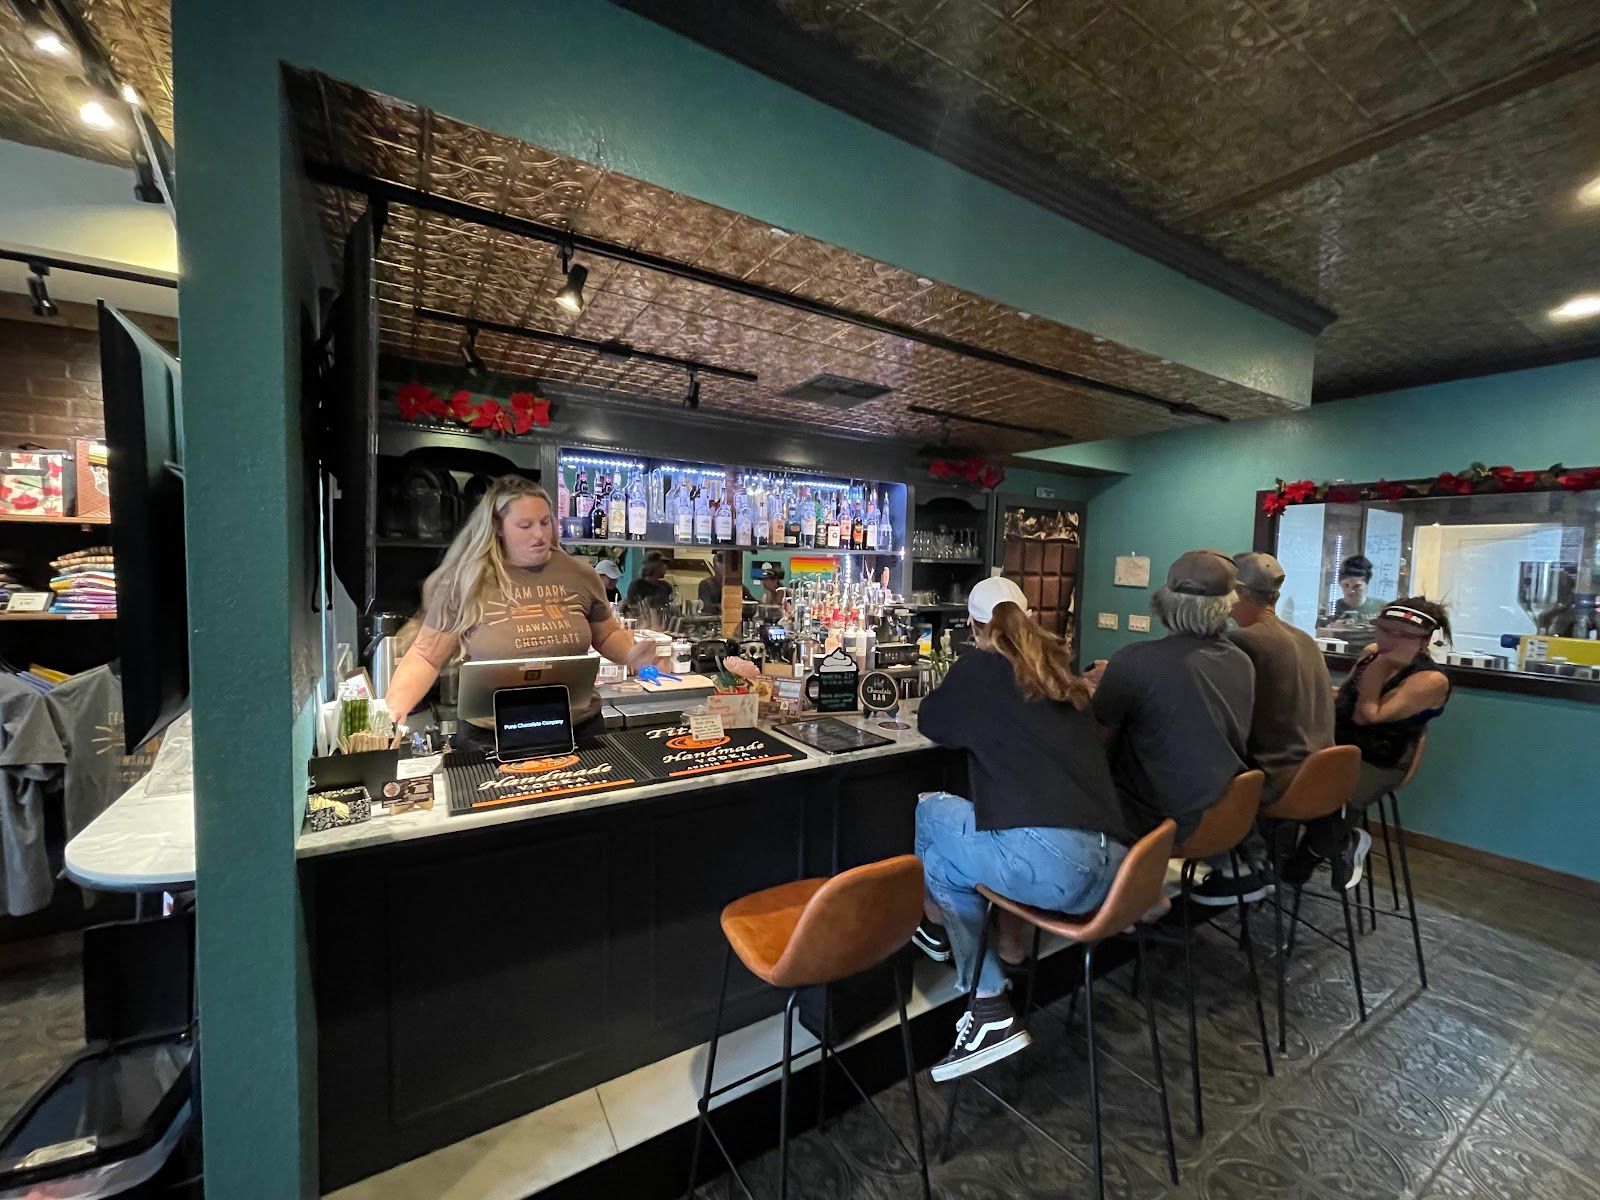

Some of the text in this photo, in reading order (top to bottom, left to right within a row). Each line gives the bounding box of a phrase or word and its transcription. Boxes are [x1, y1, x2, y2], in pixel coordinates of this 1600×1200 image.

[537, 585, 567, 597] DARK
[517, 620, 571, 633] HAWAIIAN
[515, 633, 580, 649] CHOCOLATE
[646, 726, 693, 740] Tit
[662, 741, 765, 764] Handmade
[695, 752, 751, 764] VODKA
[477, 762, 613, 791] Handmade
[517, 777, 587, 791] VODKA
